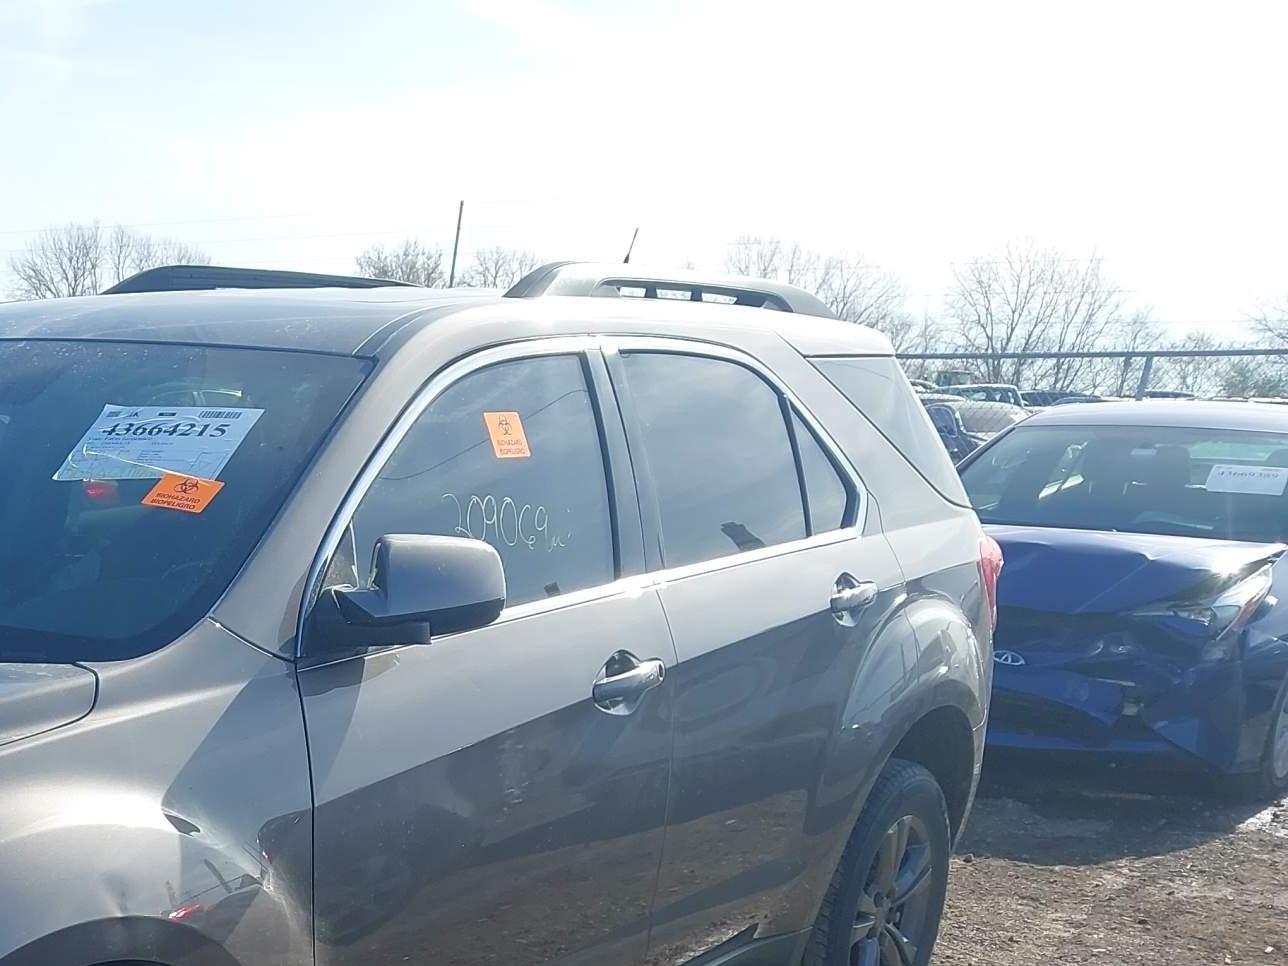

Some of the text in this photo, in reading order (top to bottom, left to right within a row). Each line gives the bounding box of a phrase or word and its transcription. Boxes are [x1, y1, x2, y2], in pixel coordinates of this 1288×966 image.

[103, 422, 231, 438] 43664215
[150, 498, 196, 510] BIOPELIGRO
[154, 492, 201, 504] BIOHAZARD
